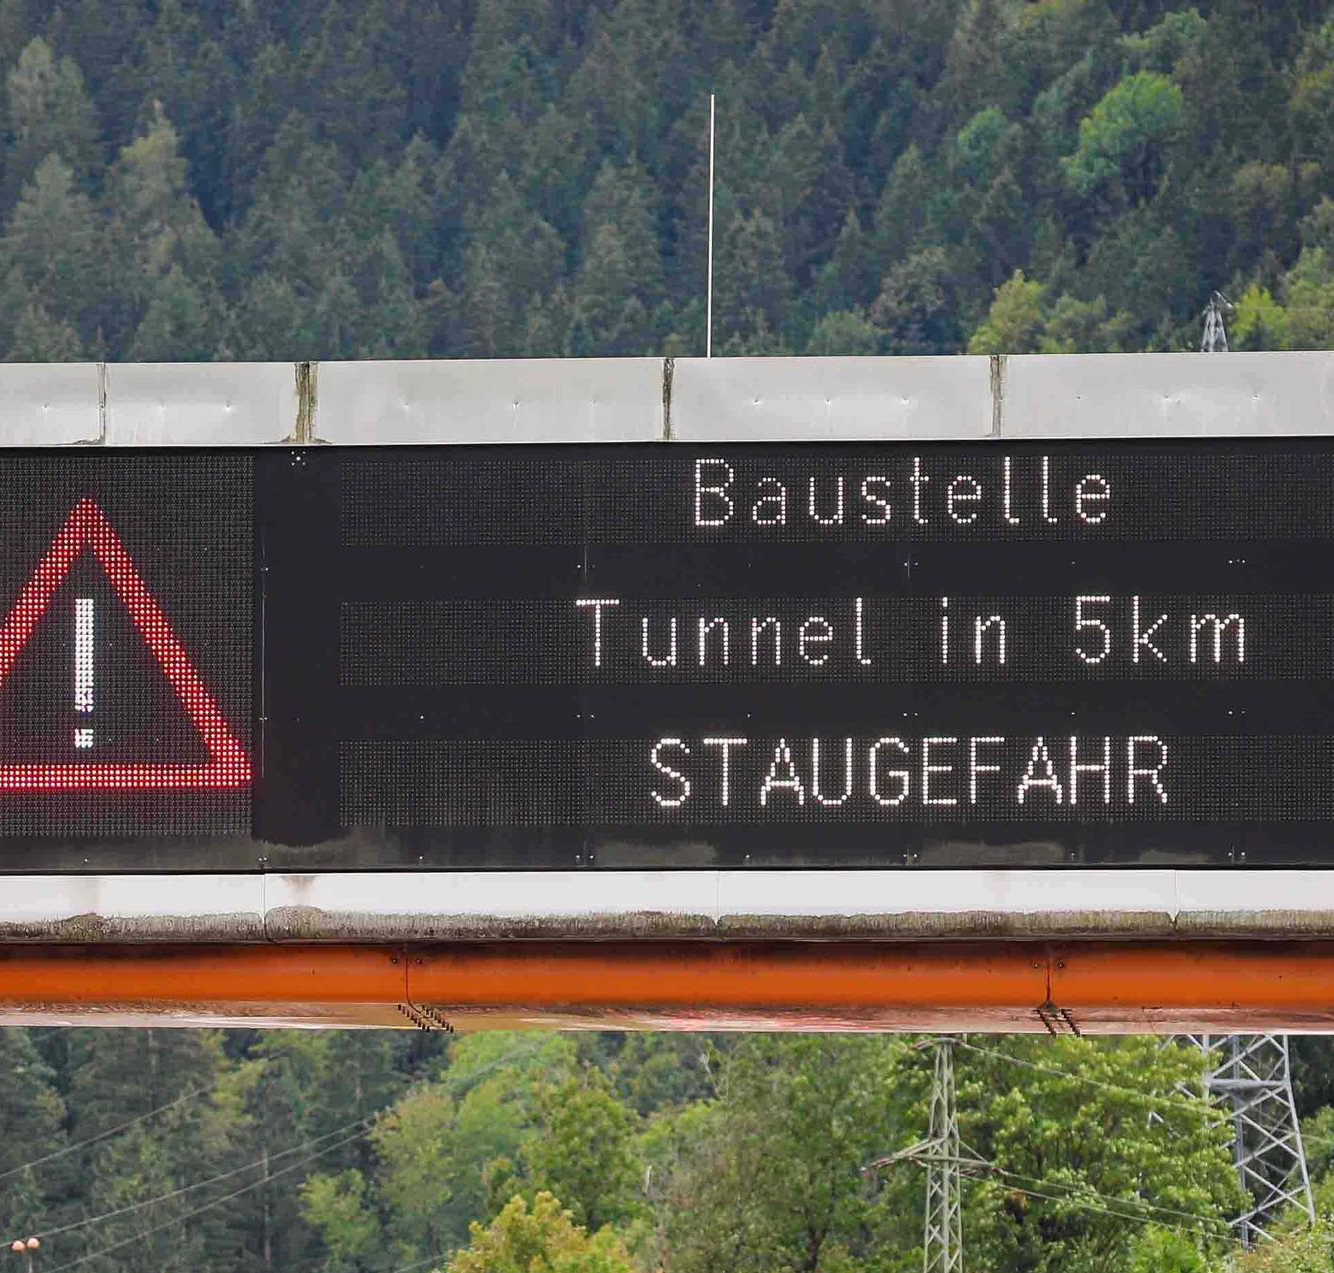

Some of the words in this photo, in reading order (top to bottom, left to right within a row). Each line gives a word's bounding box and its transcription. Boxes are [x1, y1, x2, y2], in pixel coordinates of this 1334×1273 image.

[693, 456, 1112, 527] Baustelle
[575, 596, 872, 667] Tunnel
[940, 596, 1007, 665] in
[1074, 594, 1246, 664] 5km
[649, 737, 1169, 807] STAUGEFAHR
